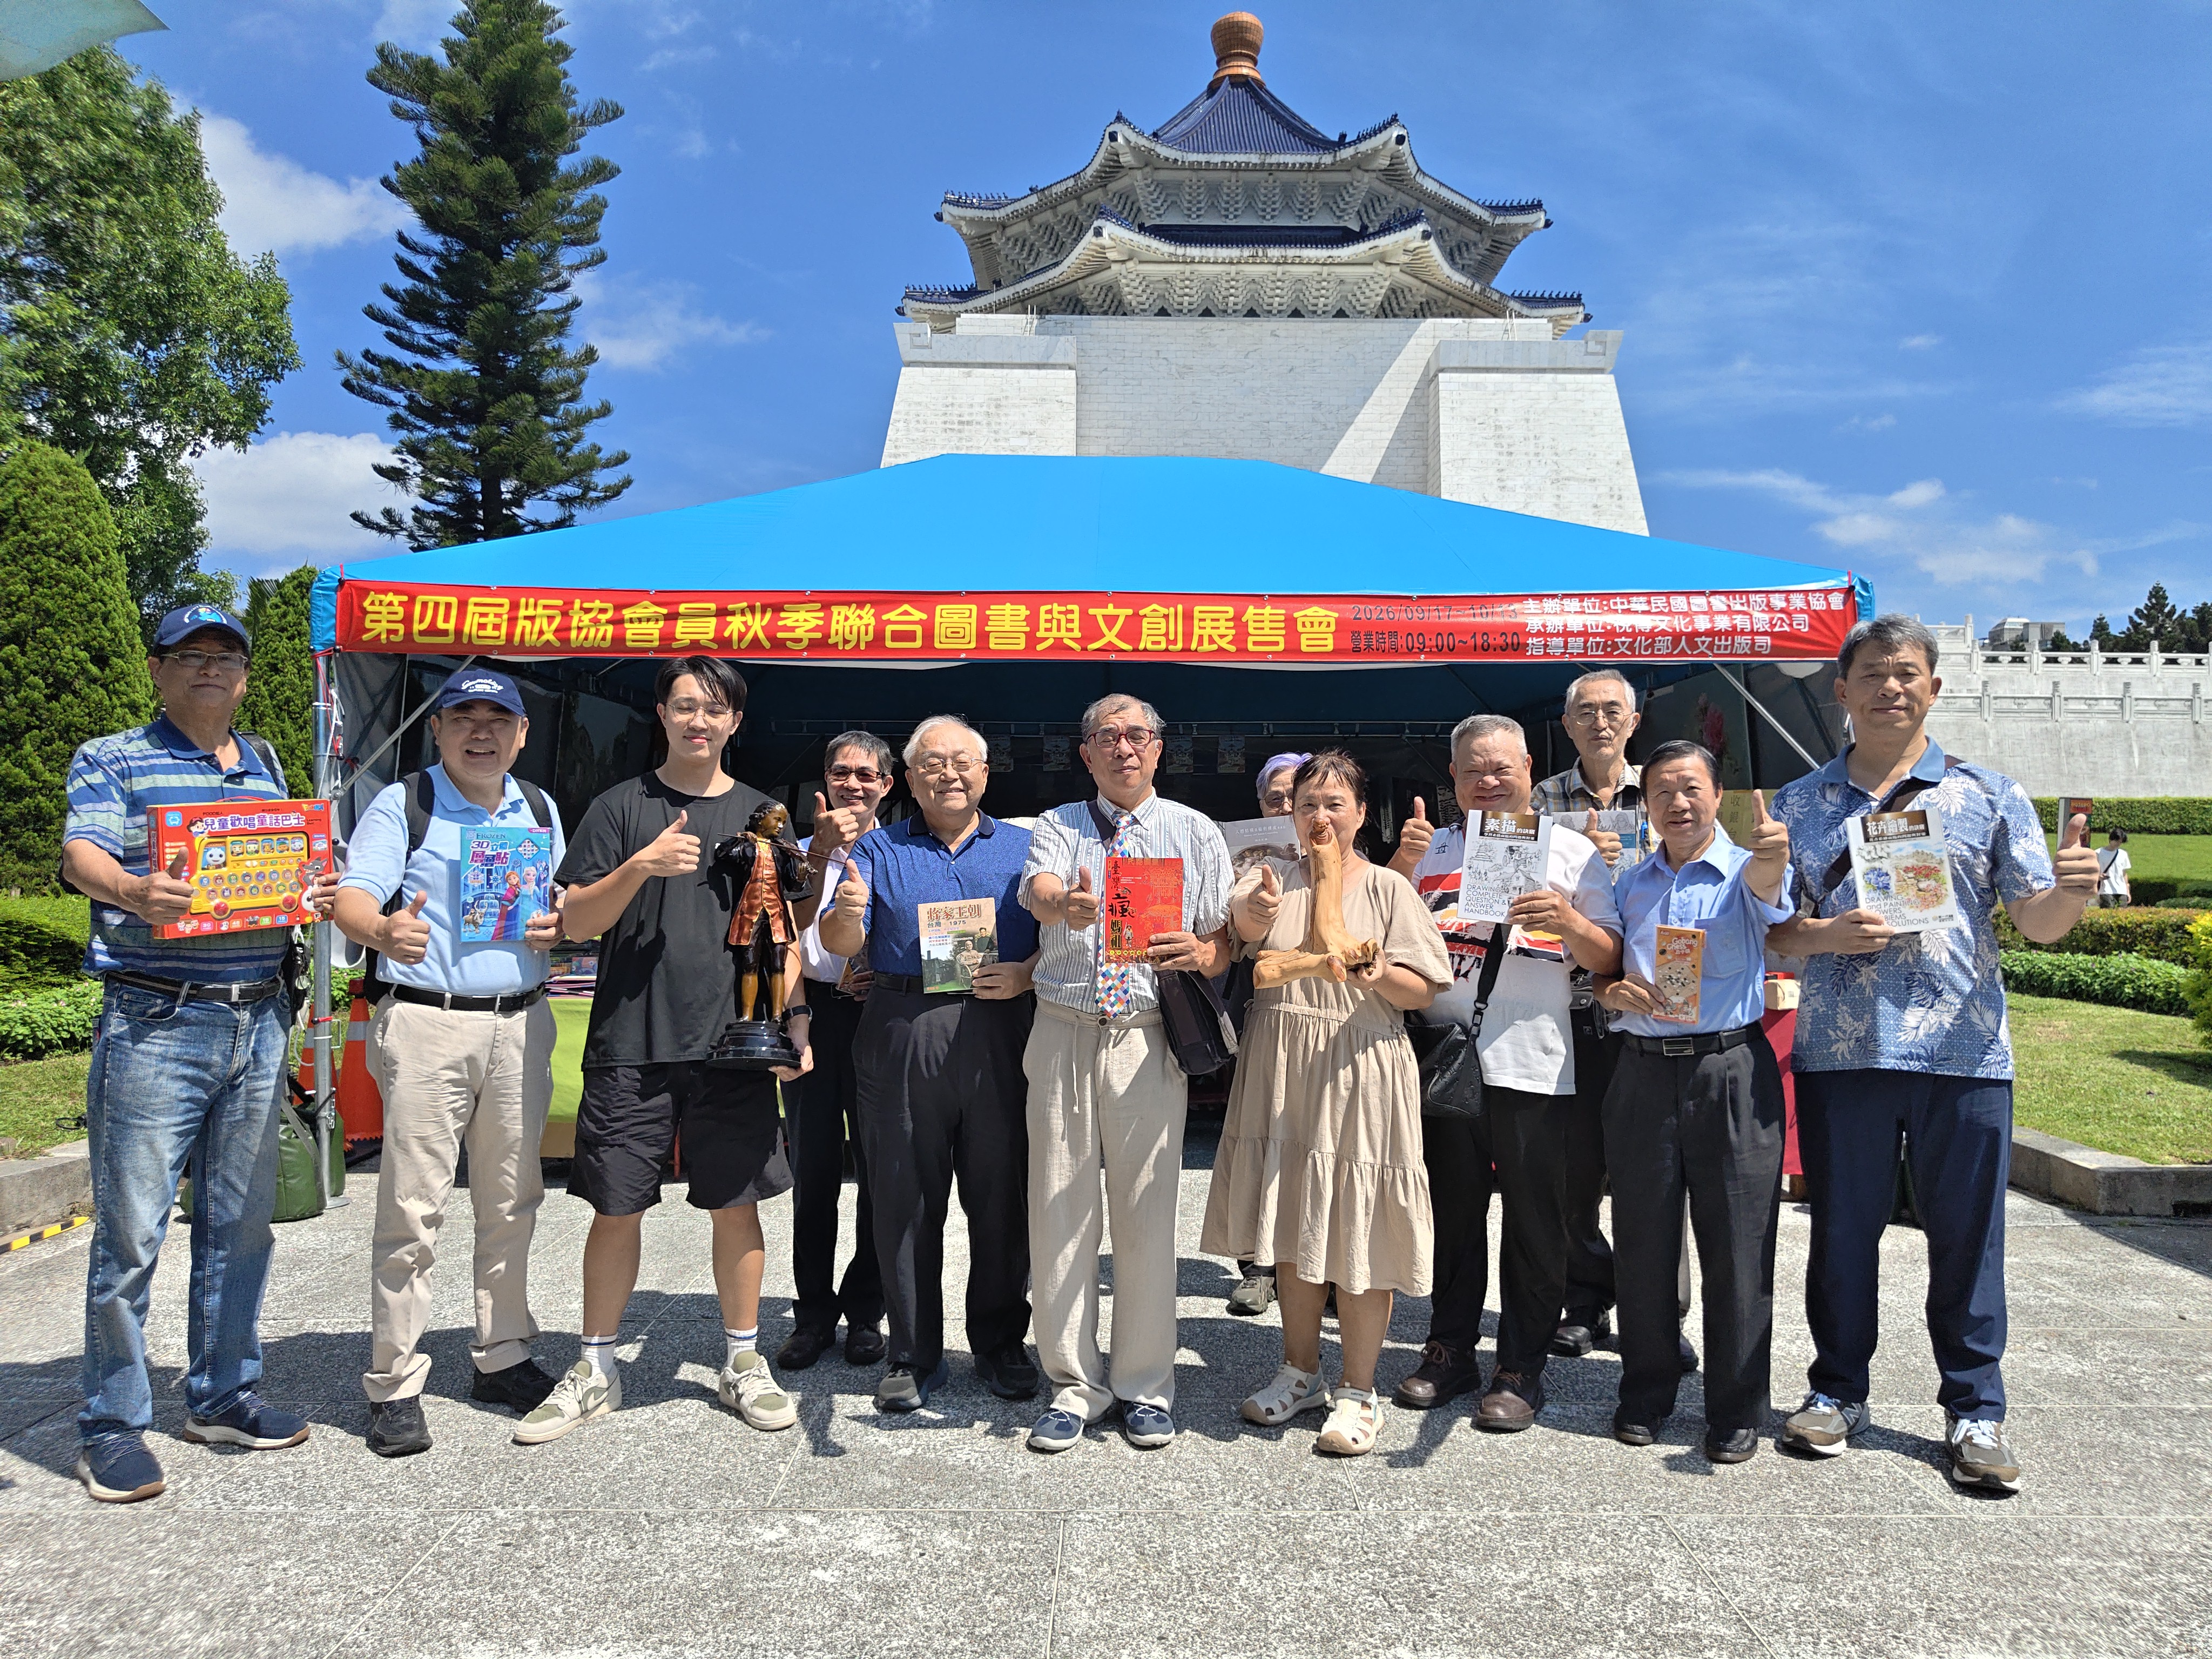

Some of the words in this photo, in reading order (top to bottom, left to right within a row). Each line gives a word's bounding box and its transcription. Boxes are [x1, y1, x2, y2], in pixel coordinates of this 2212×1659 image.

[361, 591, 1340, 653] 第四屆版協會員秋季聯合圖書與文創展售會
[1526, 635, 1771, 656] 指導單位:文化部人文出版司
[204, 814, 305, 831] 兒童歡唱童話巴士
[1466, 884, 1502, 893] DRAWING
[1466, 890, 1503, 899] COMPLETE
[1865, 895, 1904, 904] DRAWING
[1465, 895, 1500, 905] QUESTION
[1883, 899, 1920, 909] PAINTING
[1465, 901, 1494, 910] ANSWER
[1464, 907, 1506, 918] HANDBOOK
